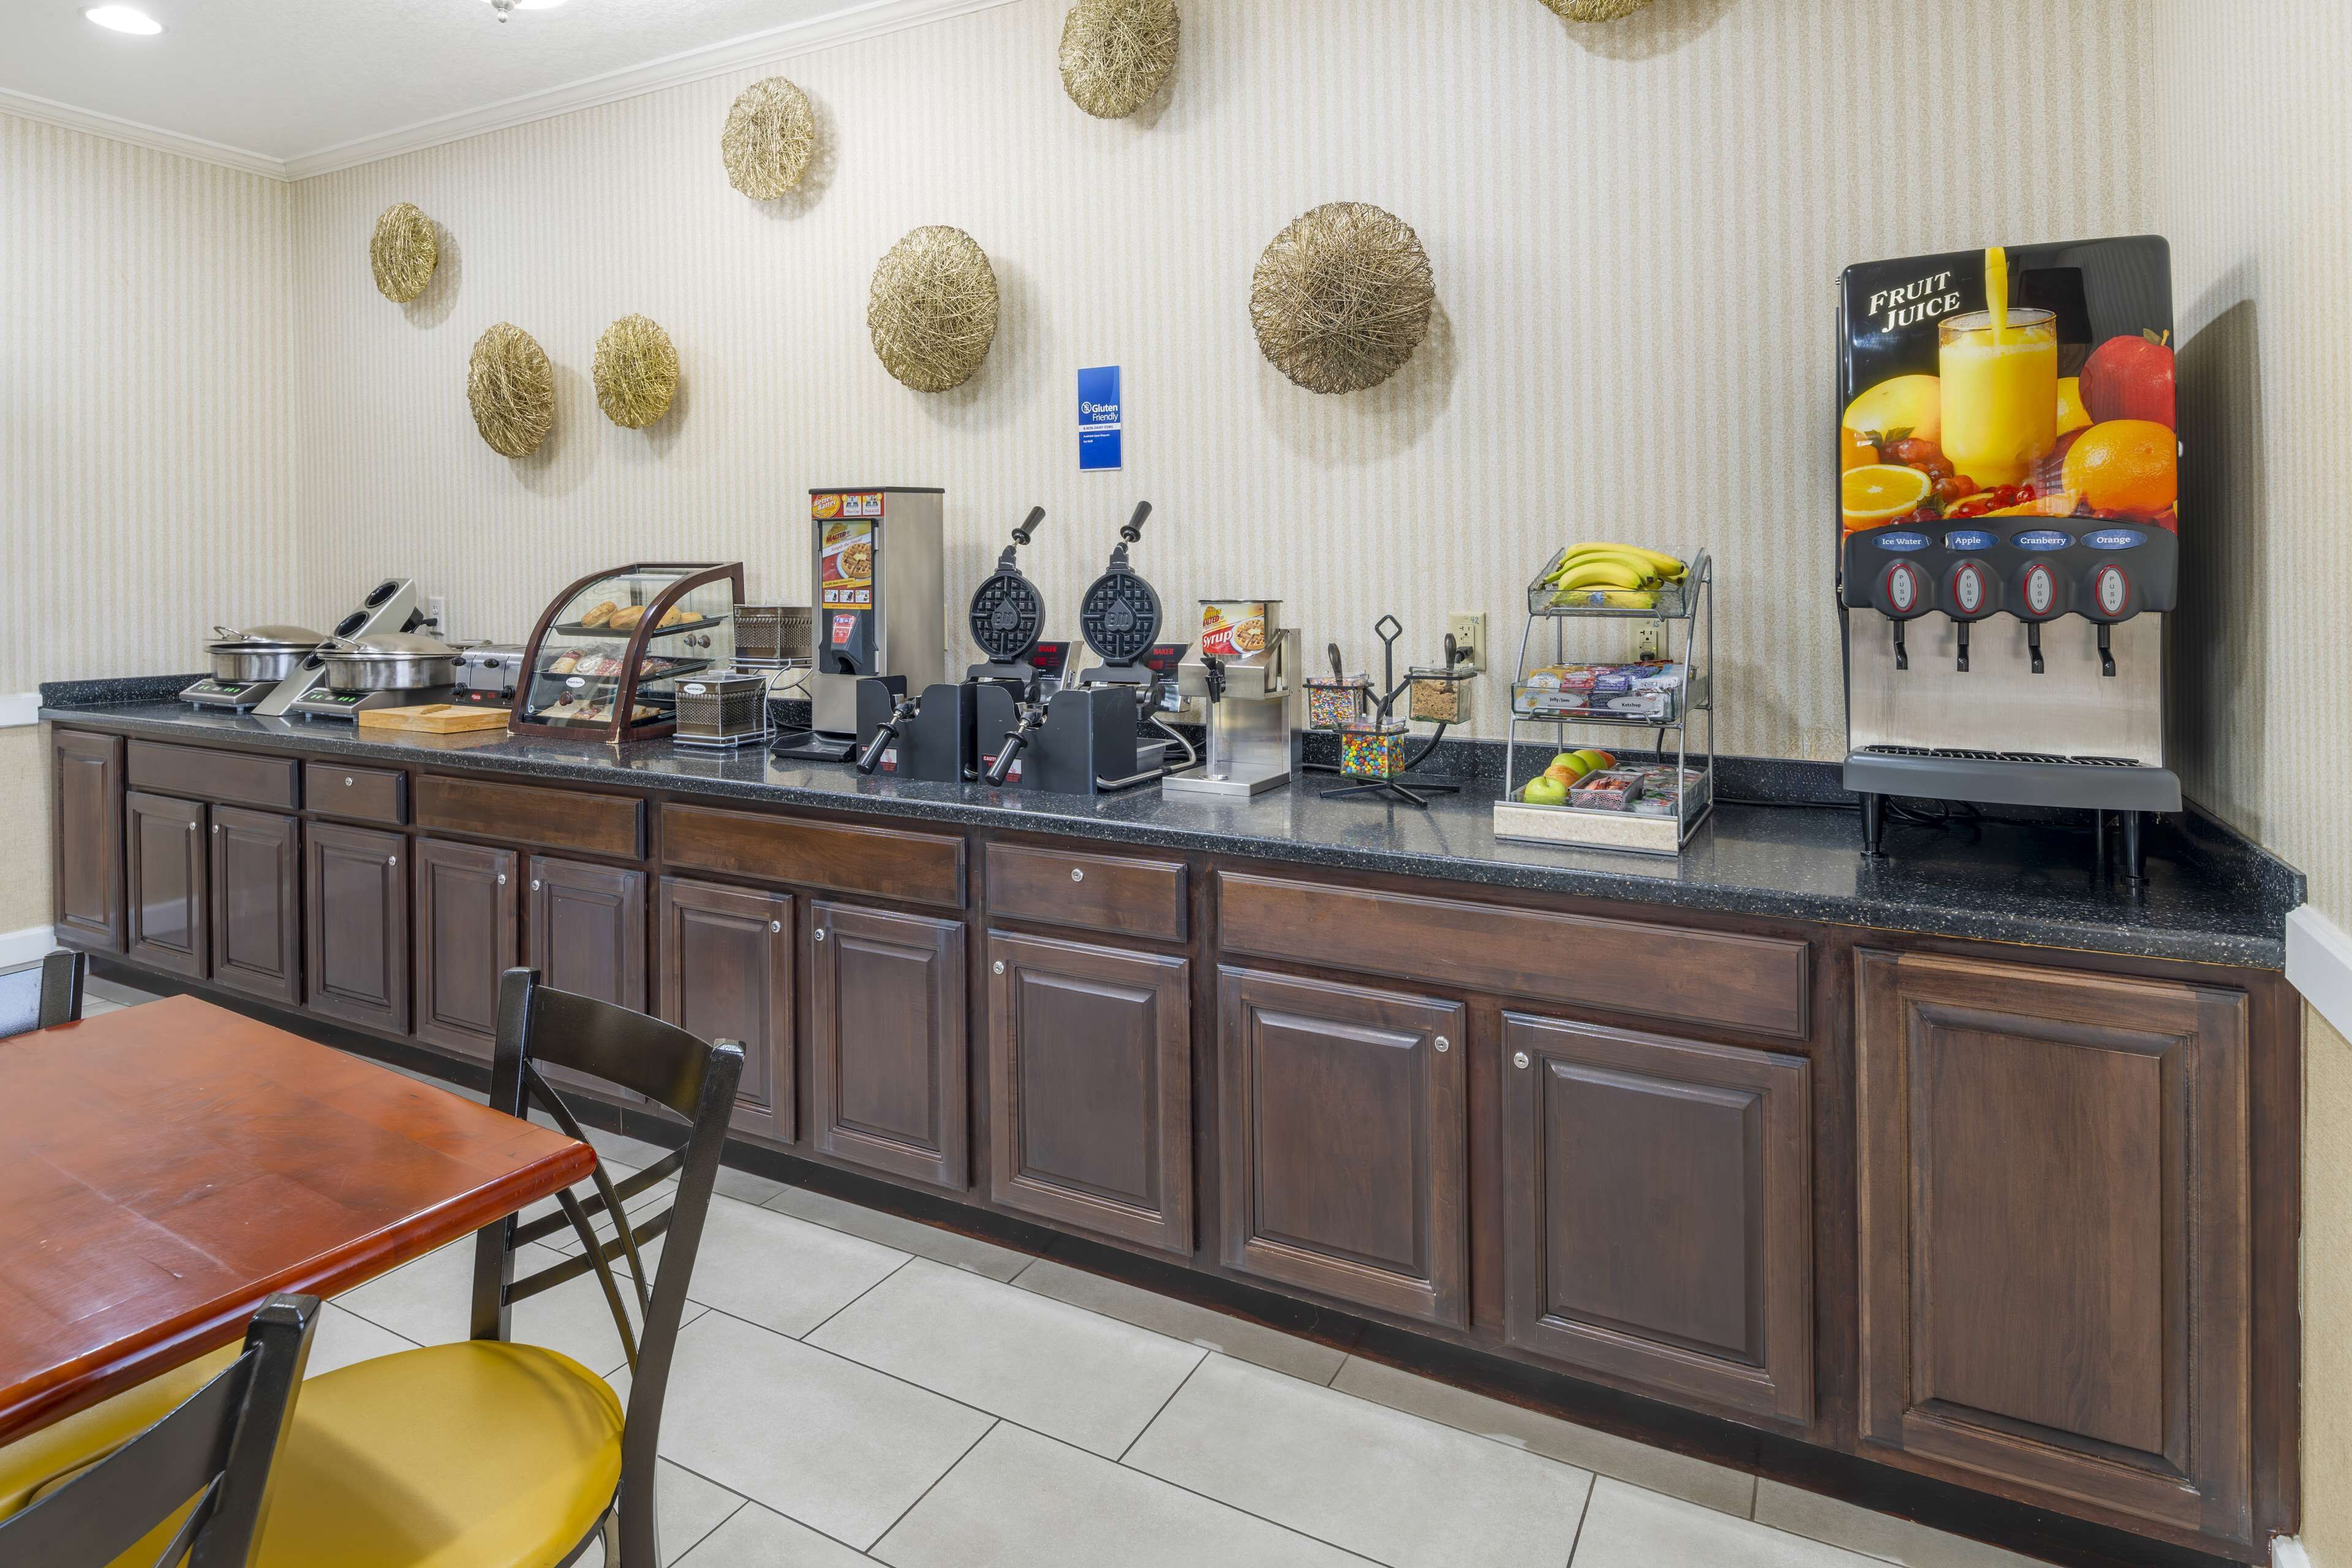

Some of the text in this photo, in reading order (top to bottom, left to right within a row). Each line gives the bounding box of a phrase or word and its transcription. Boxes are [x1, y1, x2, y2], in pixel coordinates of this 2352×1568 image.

[1868, 271, 1951, 316] FRUIT
[1882, 292, 1960, 333] JUICE
[1091, 404, 1118, 412] Gluten
[1093, 412, 1118, 421] Friendly
[813, 496, 833, 507] Better
[818, 500, 837, 510] Batter
[1955, 537, 1981, 546] Apple
[2020, 537, 2067, 545] Cranberry
[1204, 631, 1232, 647] Syrup
